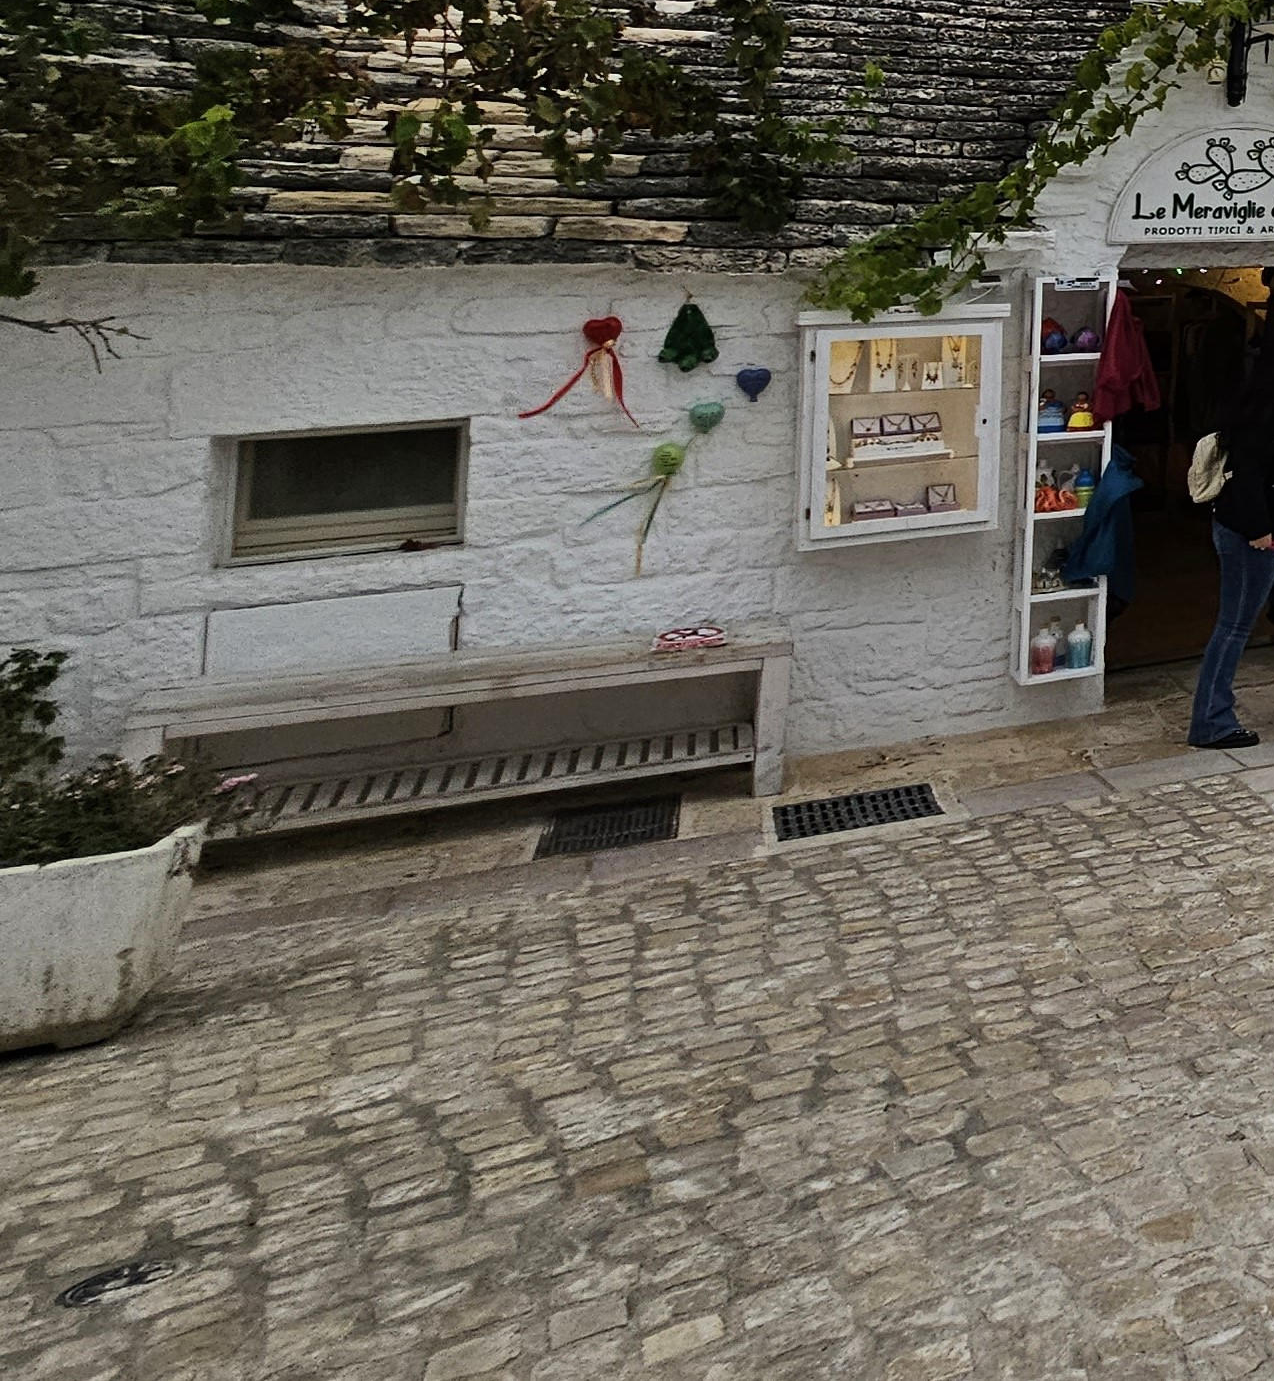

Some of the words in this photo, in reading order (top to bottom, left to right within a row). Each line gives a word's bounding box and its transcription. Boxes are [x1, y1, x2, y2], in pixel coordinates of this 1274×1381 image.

[1132, 192, 1166, 220] Le
[1172, 192, 1265, 225] Meraviglie
[1144, 226, 1202, 236] PRODOTTI
[1208, 225, 1241, 235] TIPICI
[1246, 225, 1254, 234] &
